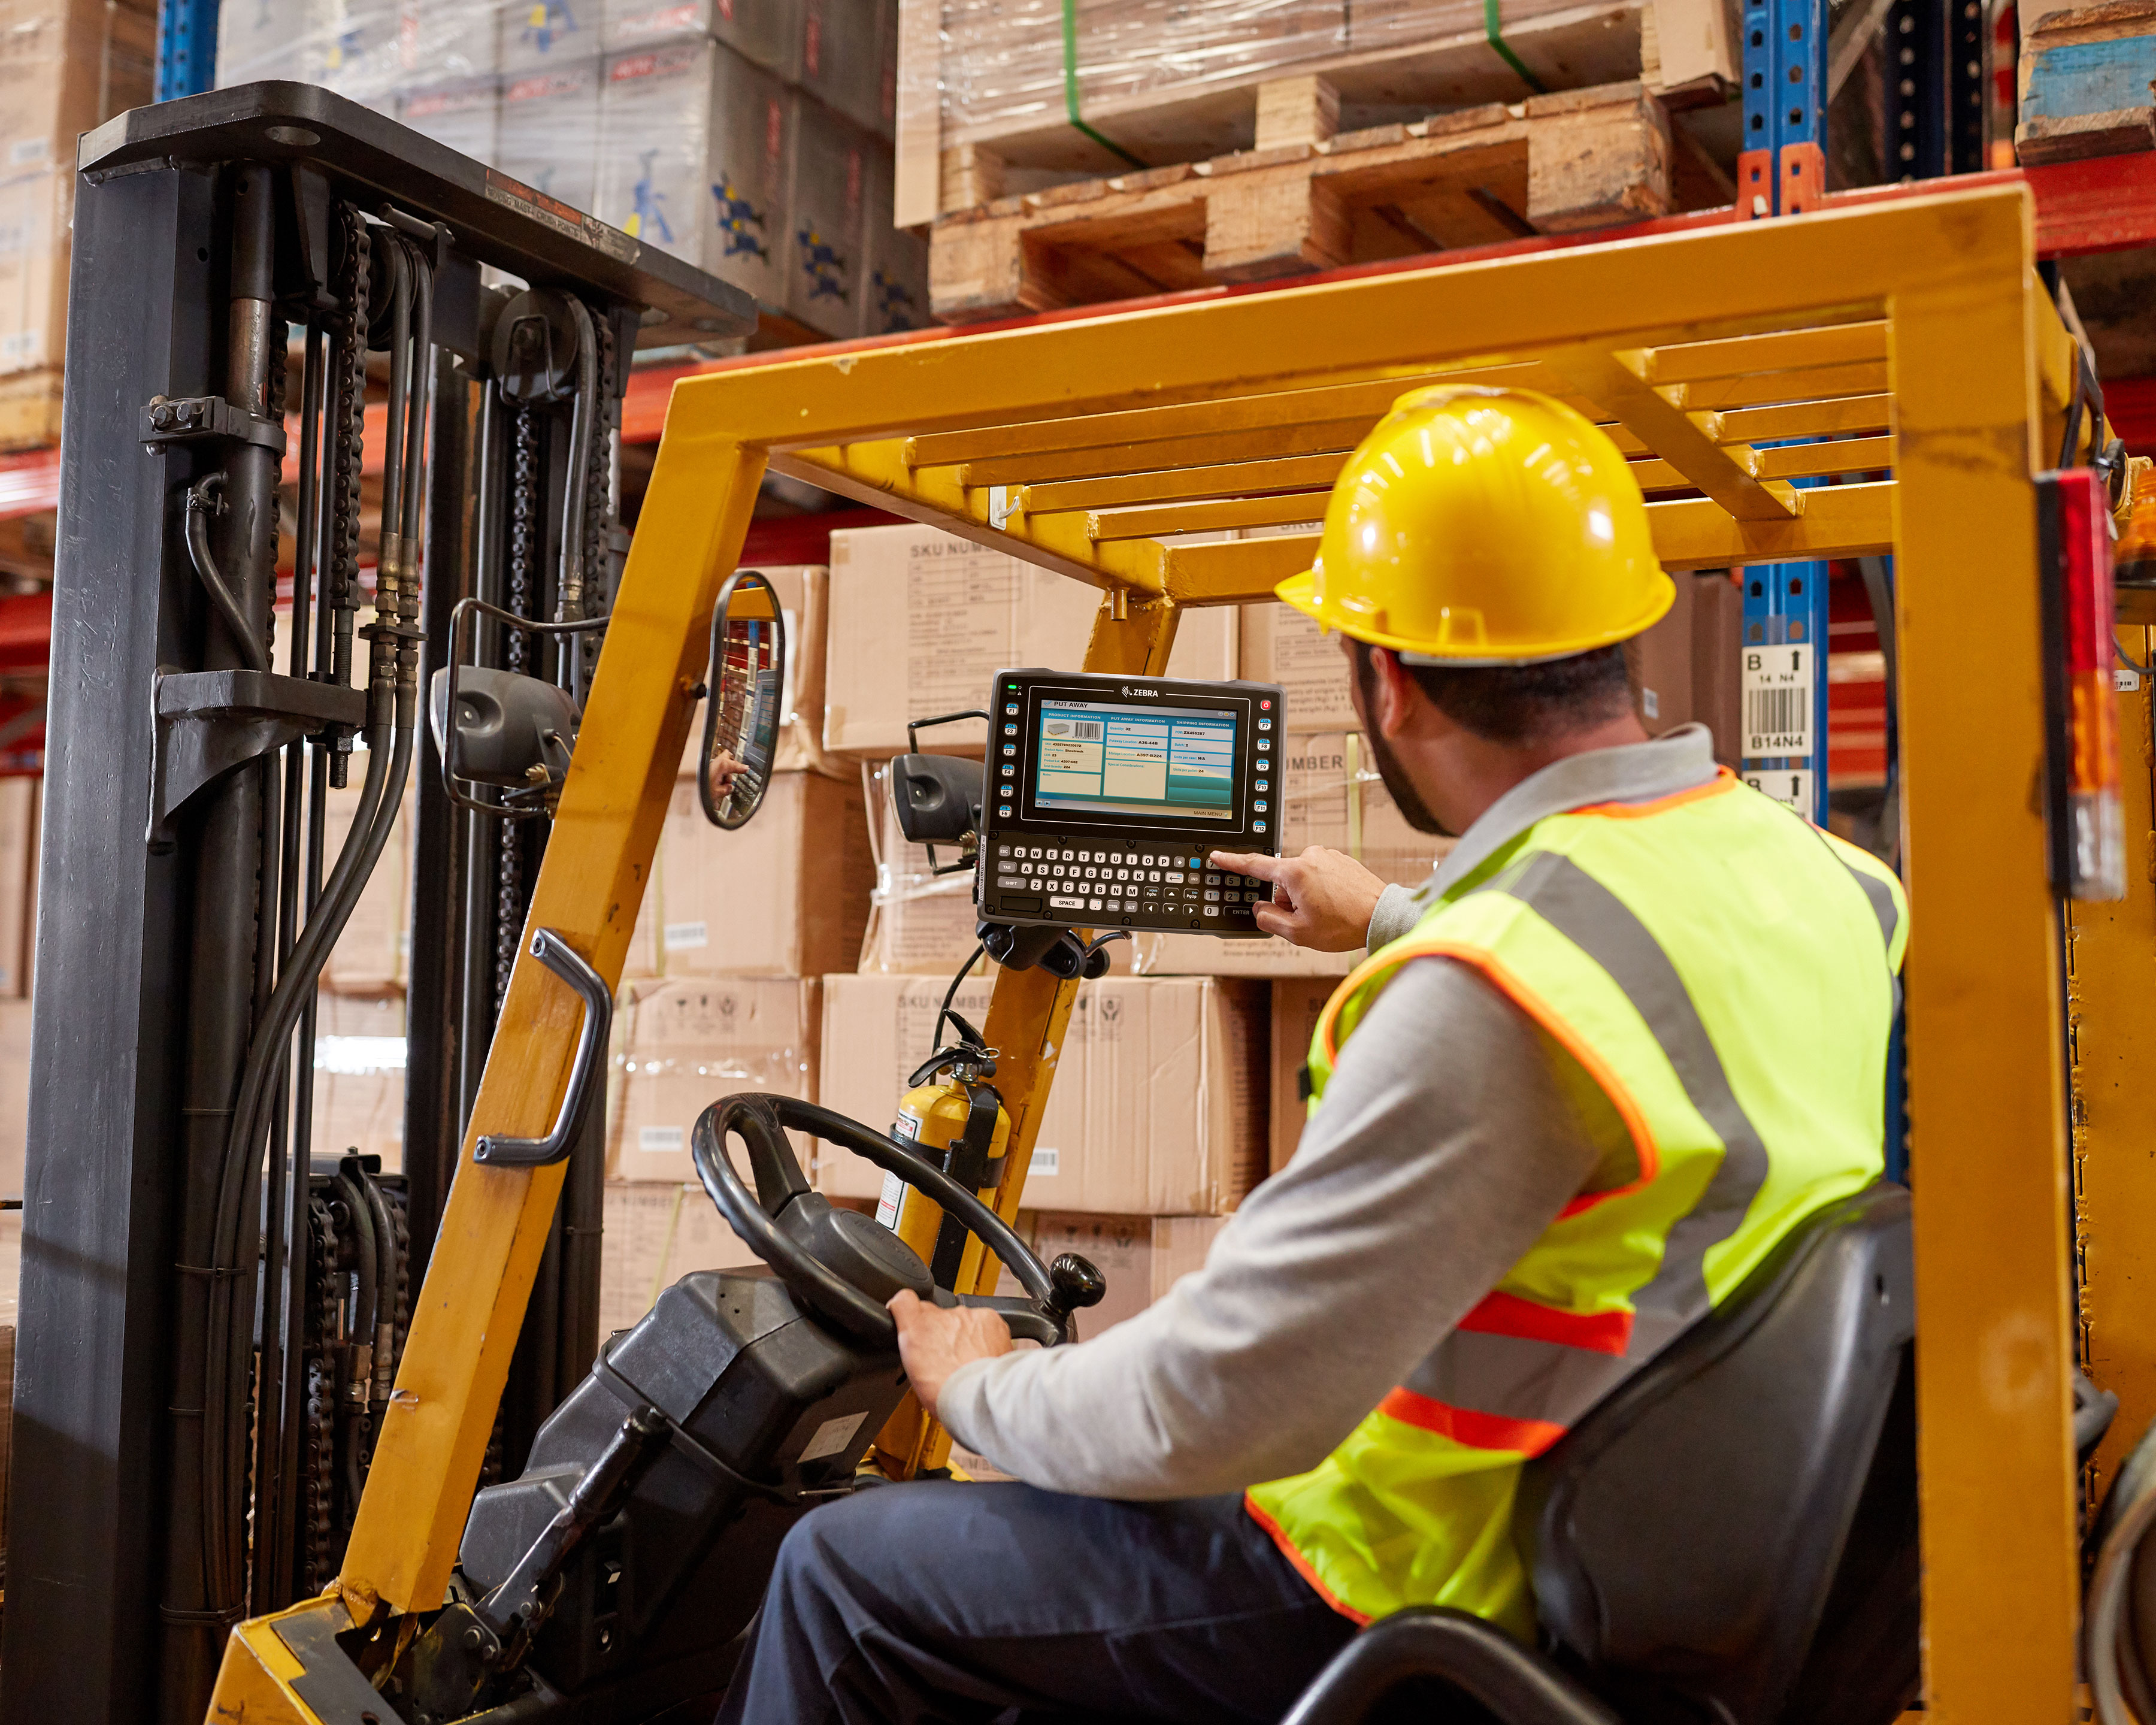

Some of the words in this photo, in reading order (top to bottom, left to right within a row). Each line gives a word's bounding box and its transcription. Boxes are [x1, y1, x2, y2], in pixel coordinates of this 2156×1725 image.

[910, 543, 943, 558] SKU
[1748, 655, 1761, 670] B
[1752, 736, 1803, 749] B14N4
